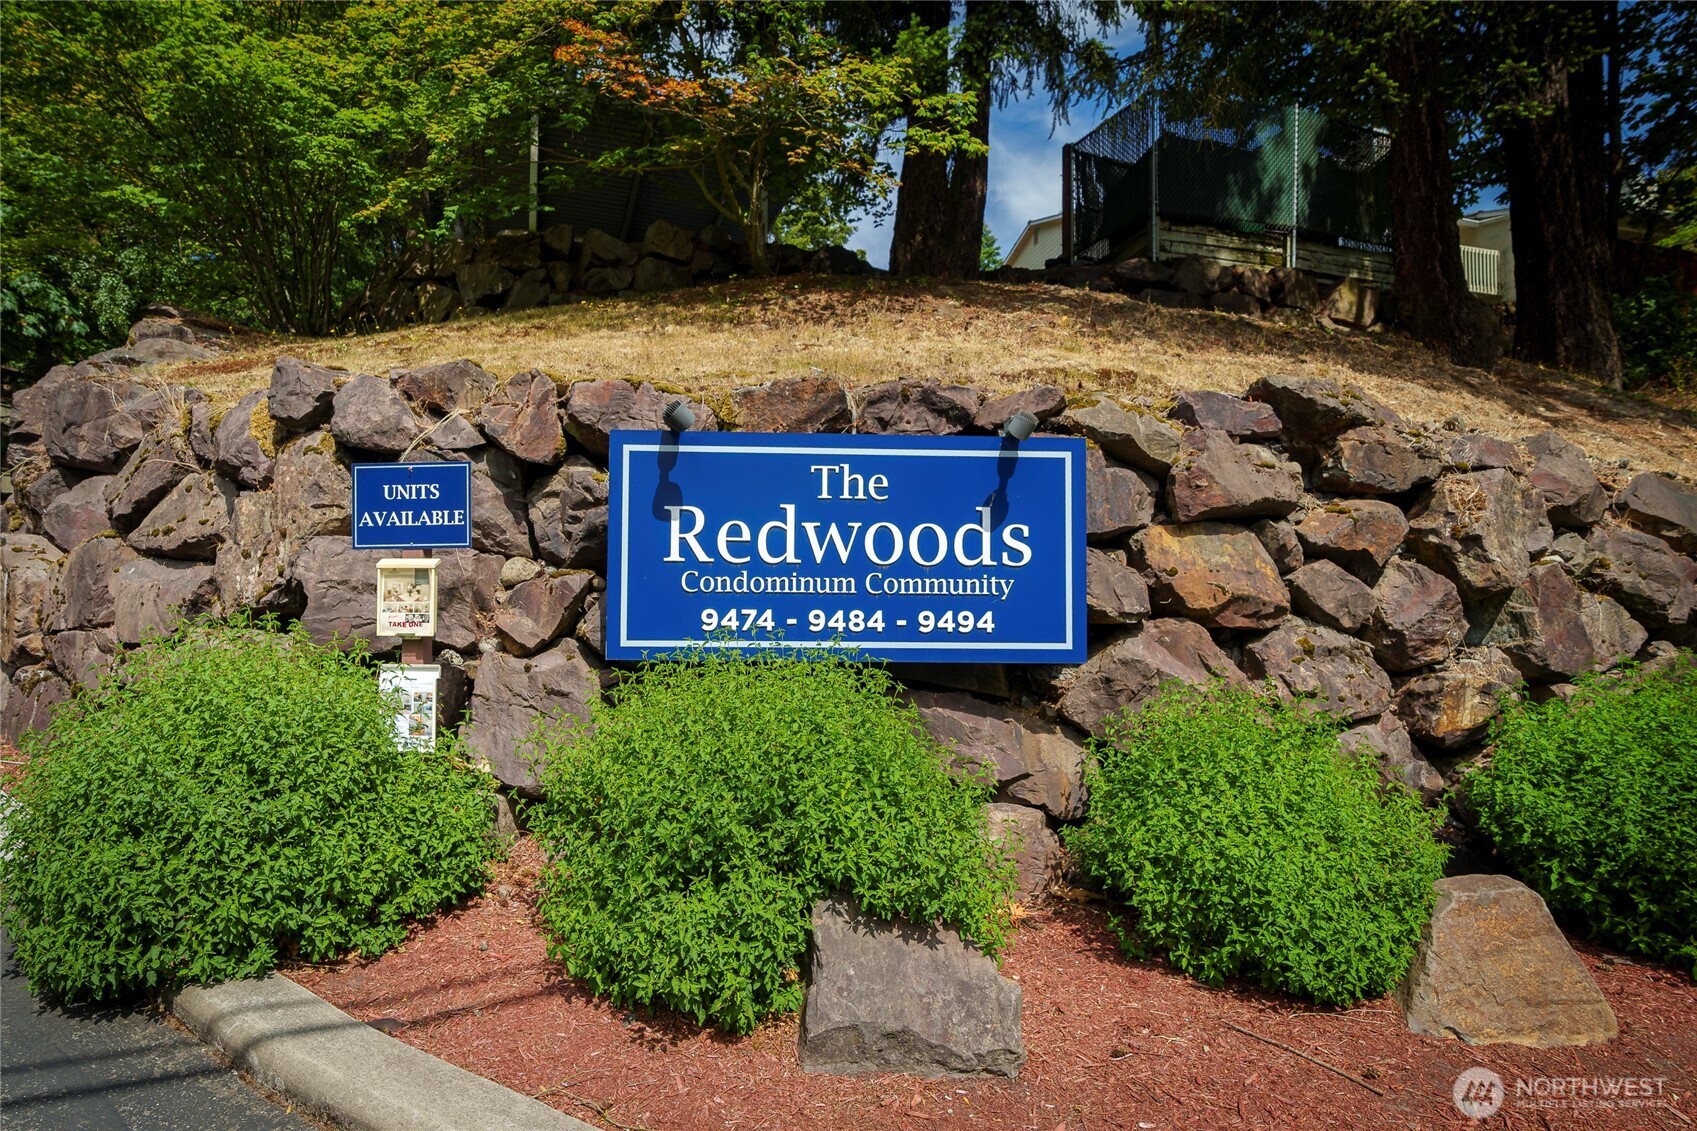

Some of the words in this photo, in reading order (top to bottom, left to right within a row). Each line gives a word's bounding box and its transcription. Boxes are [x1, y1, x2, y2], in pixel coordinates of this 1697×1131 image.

[383, 483, 440, 500] UNITS
[811, 464, 889, 500] The
[359, 510, 465, 527] AVAILABLE
[663, 503, 1032, 566] Redwoods
[681, 570, 857, 594] Condominum
[865, 573, 1015, 600] Community
[700, 608, 775, 632] 9474
[808, 609, 886, 633] 9484
[917, 610, 996, 633] 9494
